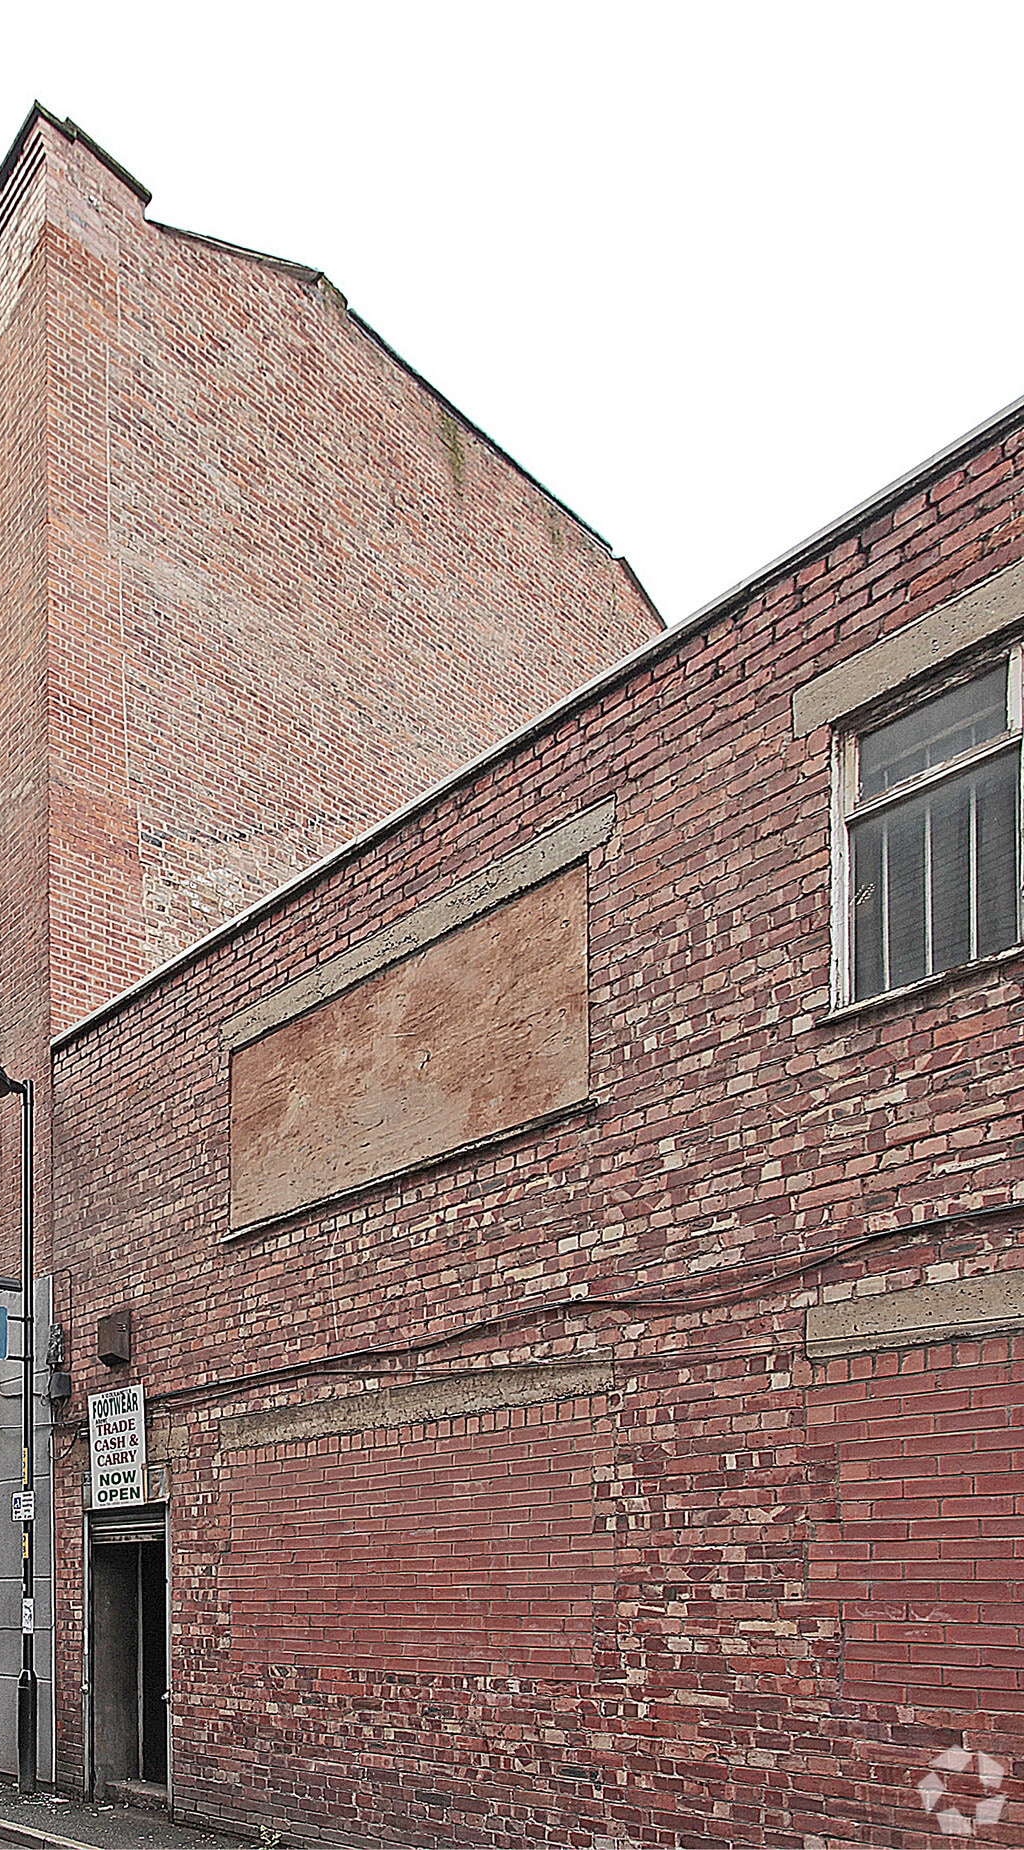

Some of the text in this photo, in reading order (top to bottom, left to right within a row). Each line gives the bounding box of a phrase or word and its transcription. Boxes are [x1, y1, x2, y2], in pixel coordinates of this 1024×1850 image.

[92, 1393, 138, 1419] FOOTWEAR
[96, 1418, 136, 1436] TRADE
[94, 1434, 139, 1452] CASH &
[97, 1450, 137, 1467] CARRY
[99, 1470, 137, 1487] NOW
[97, 1486, 140, 1502] OPEN
